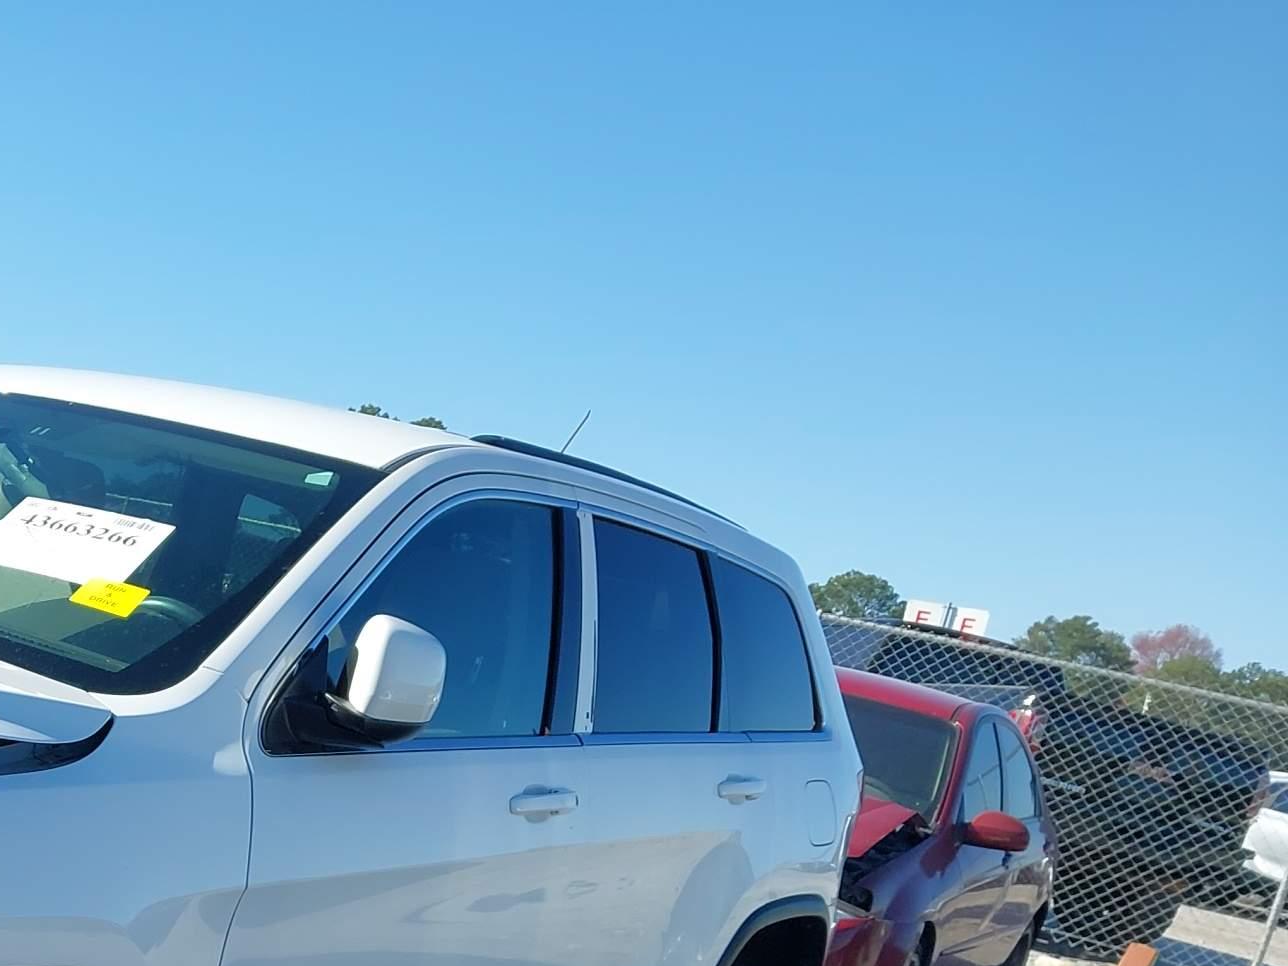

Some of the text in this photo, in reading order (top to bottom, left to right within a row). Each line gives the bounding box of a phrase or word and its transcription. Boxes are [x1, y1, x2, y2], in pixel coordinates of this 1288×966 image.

[20, 514, 137, 547] 43663266
[105, 583, 127, 593] RUN
[89, 595, 120, 608] DRIVE
